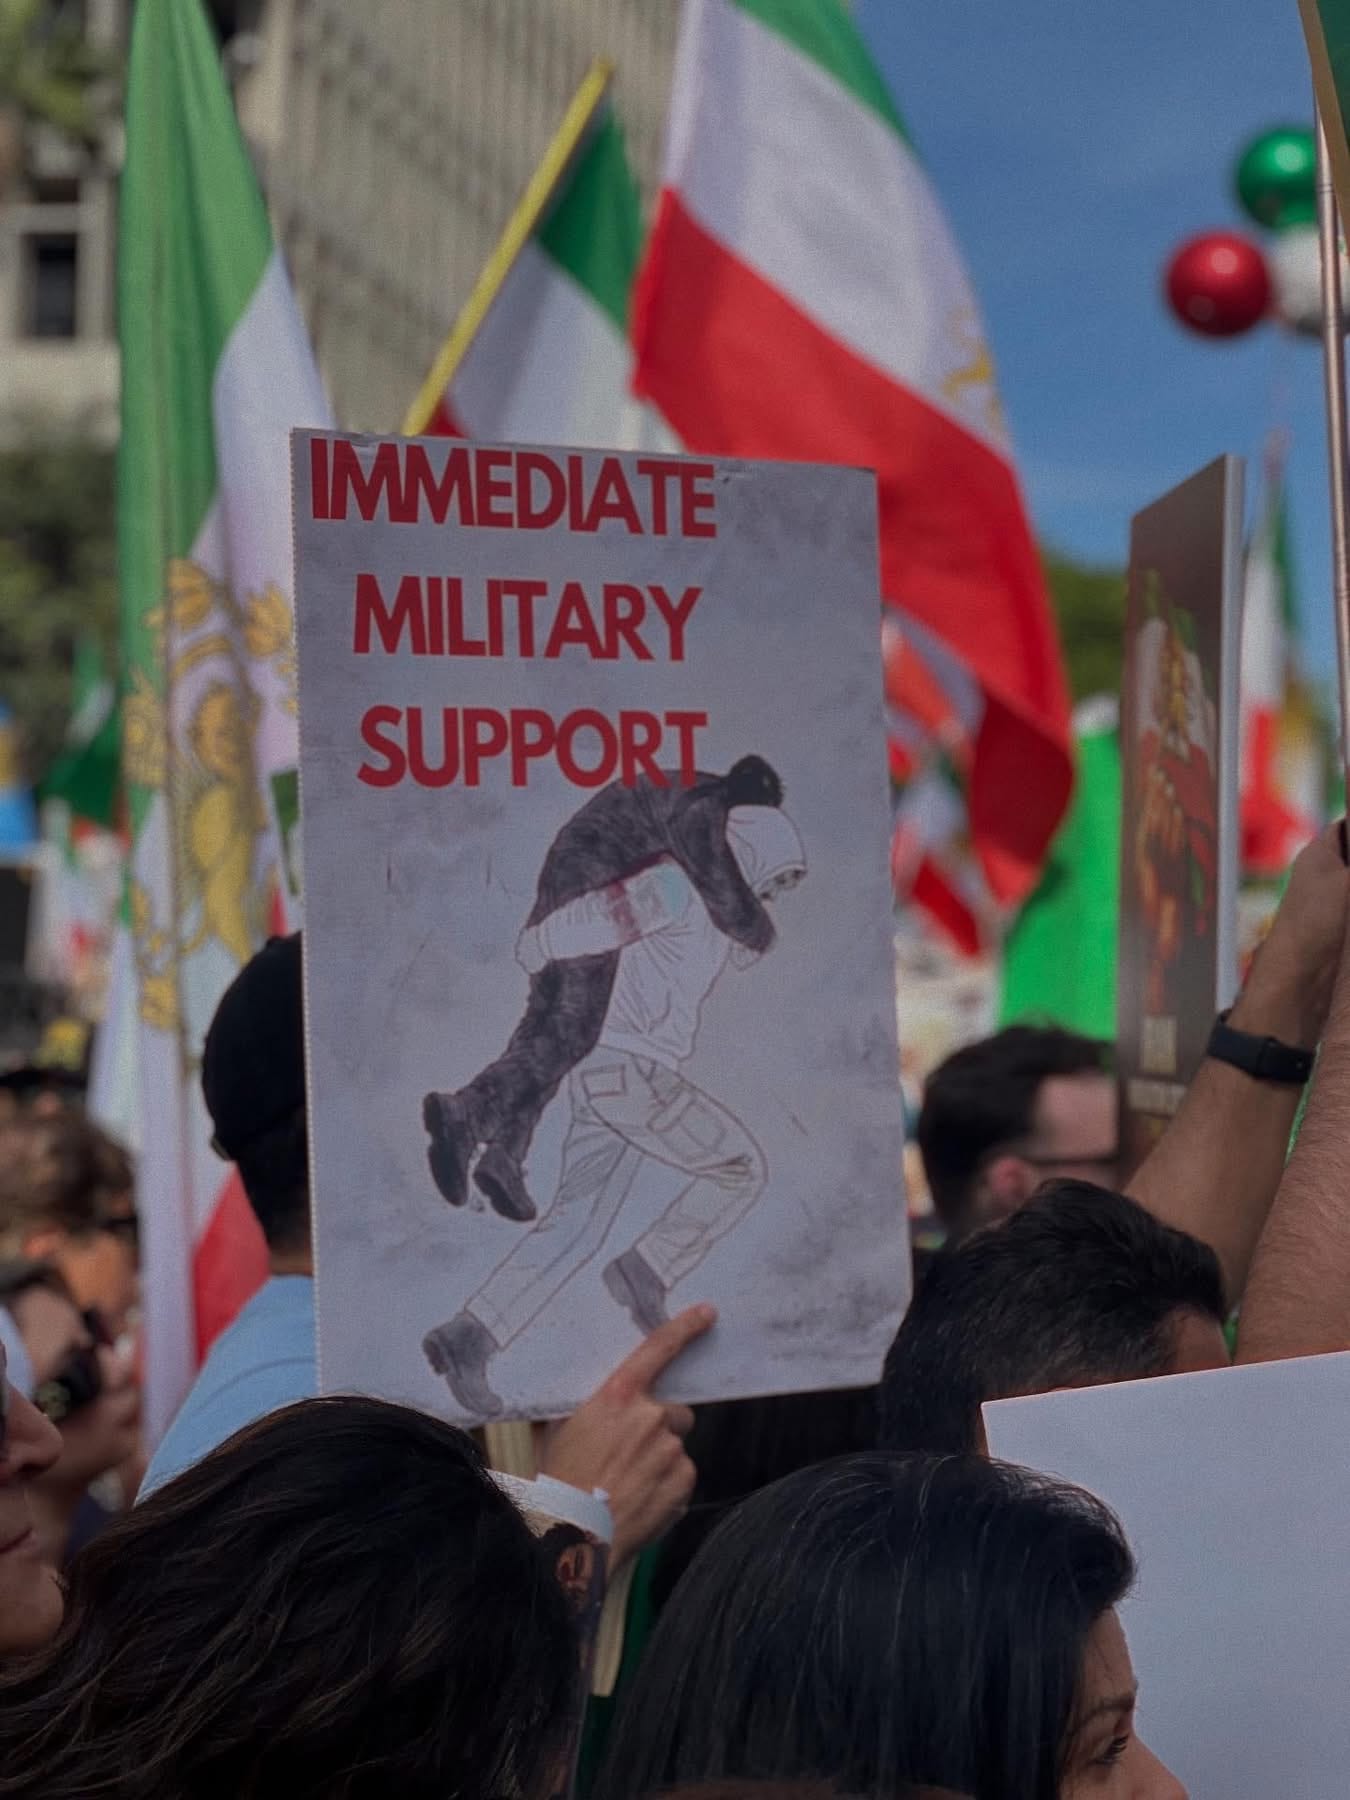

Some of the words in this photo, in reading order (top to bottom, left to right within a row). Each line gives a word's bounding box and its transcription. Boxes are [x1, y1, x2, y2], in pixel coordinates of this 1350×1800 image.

[311, 438, 716, 537] IMMEDIATE
[353, 574, 702, 662] MILITARY
[358, 705, 708, 789] SUPPORT
